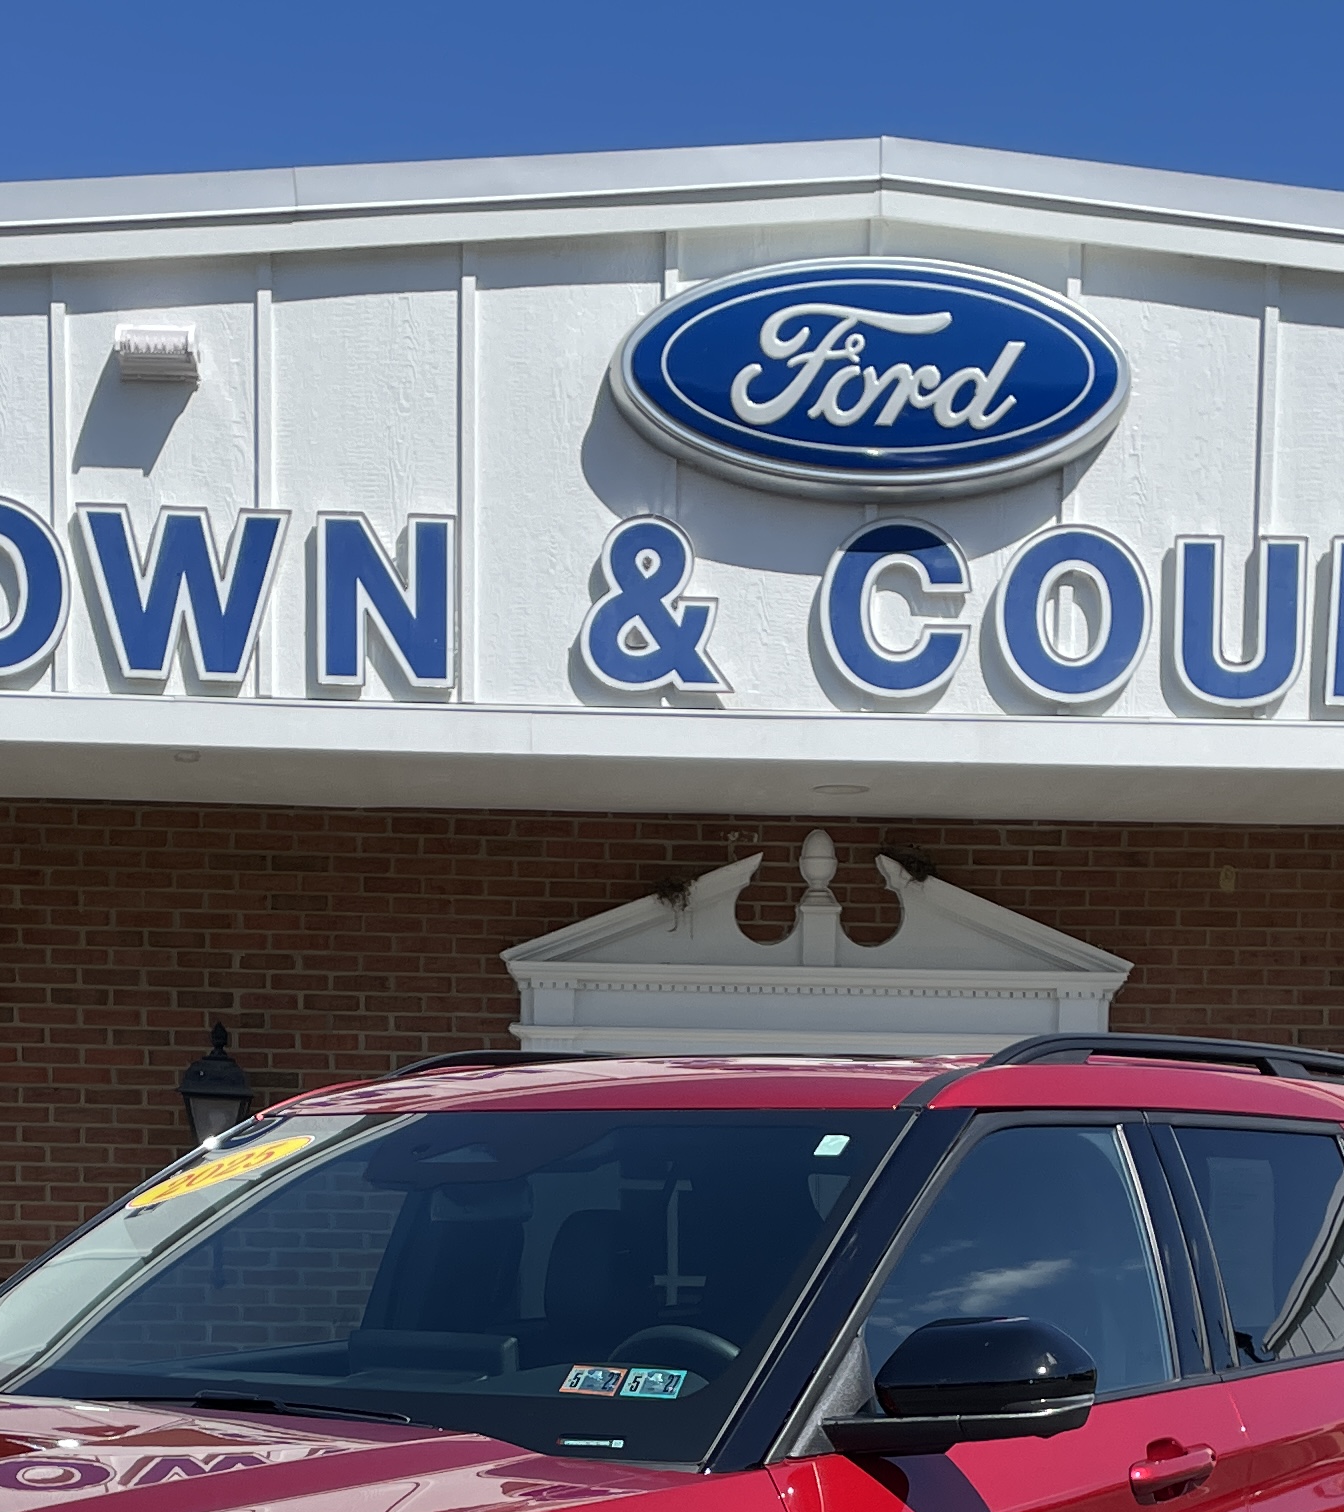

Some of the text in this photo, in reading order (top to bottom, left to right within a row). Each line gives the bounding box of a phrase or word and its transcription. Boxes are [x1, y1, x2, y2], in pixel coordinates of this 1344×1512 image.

[730, 302, 1026, 430] Ford
[581, 514, 733, 694] &
[152, 1142, 287, 1200] 2025
